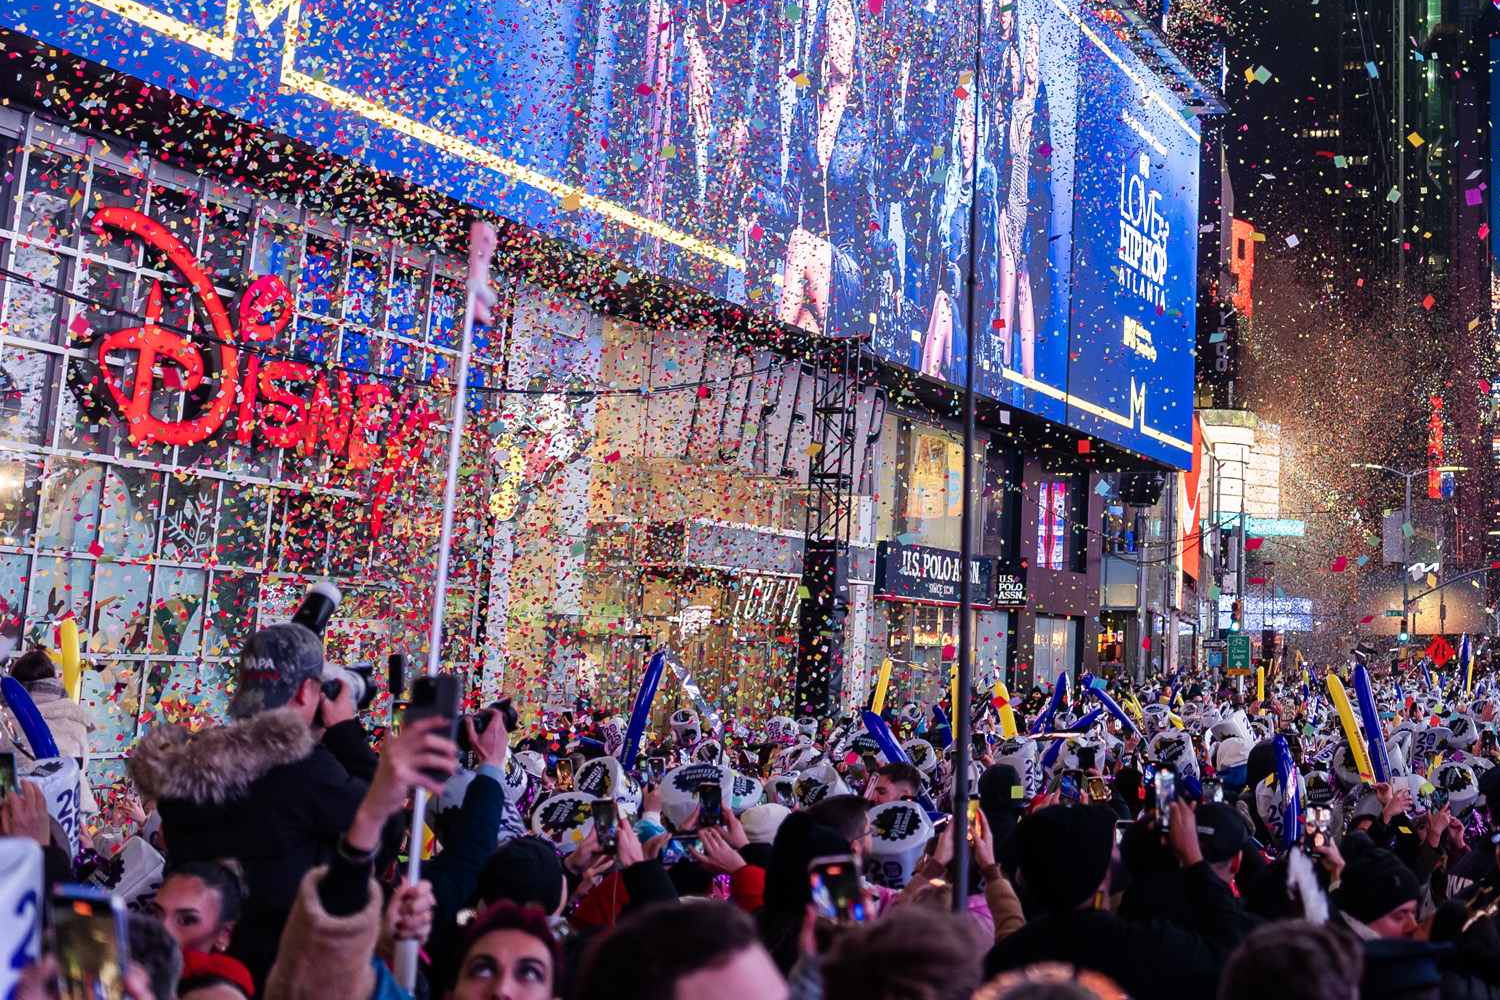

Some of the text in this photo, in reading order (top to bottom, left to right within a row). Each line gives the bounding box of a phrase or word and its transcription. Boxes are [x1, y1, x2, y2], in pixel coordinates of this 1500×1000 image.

[1120, 164, 1163, 242] LOVE
[1118, 264, 1166, 312] ATLANTA
[901, 550, 983, 585] U.S. POLO AN.
[998, 574, 1016, 583] U.S.
[998, 582, 1023, 591] POLO
[1417, 731, 1435, 745] 20
[890, 811, 904, 838] planet
[899, 808, 914, 835] fitness
